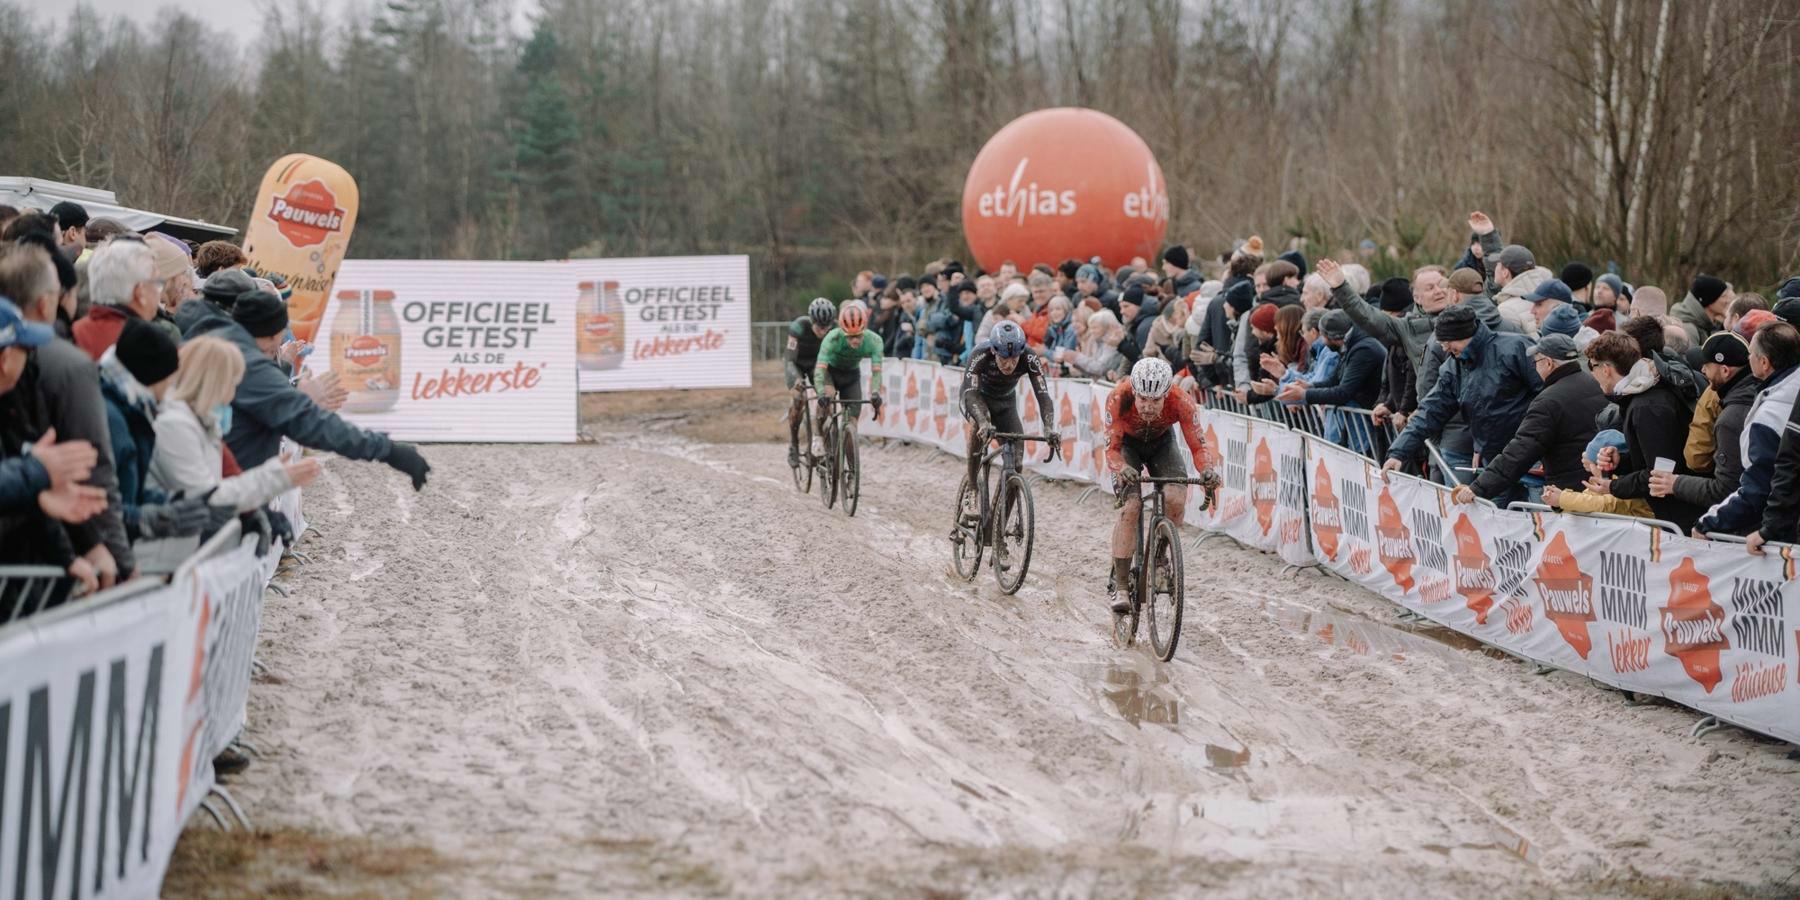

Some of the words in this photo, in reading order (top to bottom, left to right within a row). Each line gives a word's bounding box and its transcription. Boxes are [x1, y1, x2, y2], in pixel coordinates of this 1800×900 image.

[978, 157, 1077, 227] ethias
[272, 200, 340, 229] Pauwels
[402, 301, 556, 324] OFFICIEEL
[625, 286, 734, 304] OFFICIEEL
[640, 304, 722, 322] GETEST
[423, 326, 538, 349] GETEST
[452, 353, 480, 364] ALS
[484, 353, 505, 364] DE
[1312, 499, 1339, 527] Pauwels
[1341, 478, 1367, 513] MMM
[1343, 506, 1370, 542] MMM
[1412, 507, 1442, 545] MMM
[1379, 529, 1414, 559] Pauwels
[1415, 537, 1448, 575] MMM
[1457, 559, 1496, 590] Pauwels
[1600, 551, 1647, 594] MMM
[1540, 580, 1590, 614] Pauwels
[1601, 586, 1648, 631] MMM
[1731, 576, 1784, 617] MMM
[1664, 609, 1723, 644] Pauwels
[1731, 614, 1786, 658] MMM
[1608, 628, 1651, 674] lekker
[1732, 662, 1787, 703] délicieuse
[0, 641, 165, 900] MM
